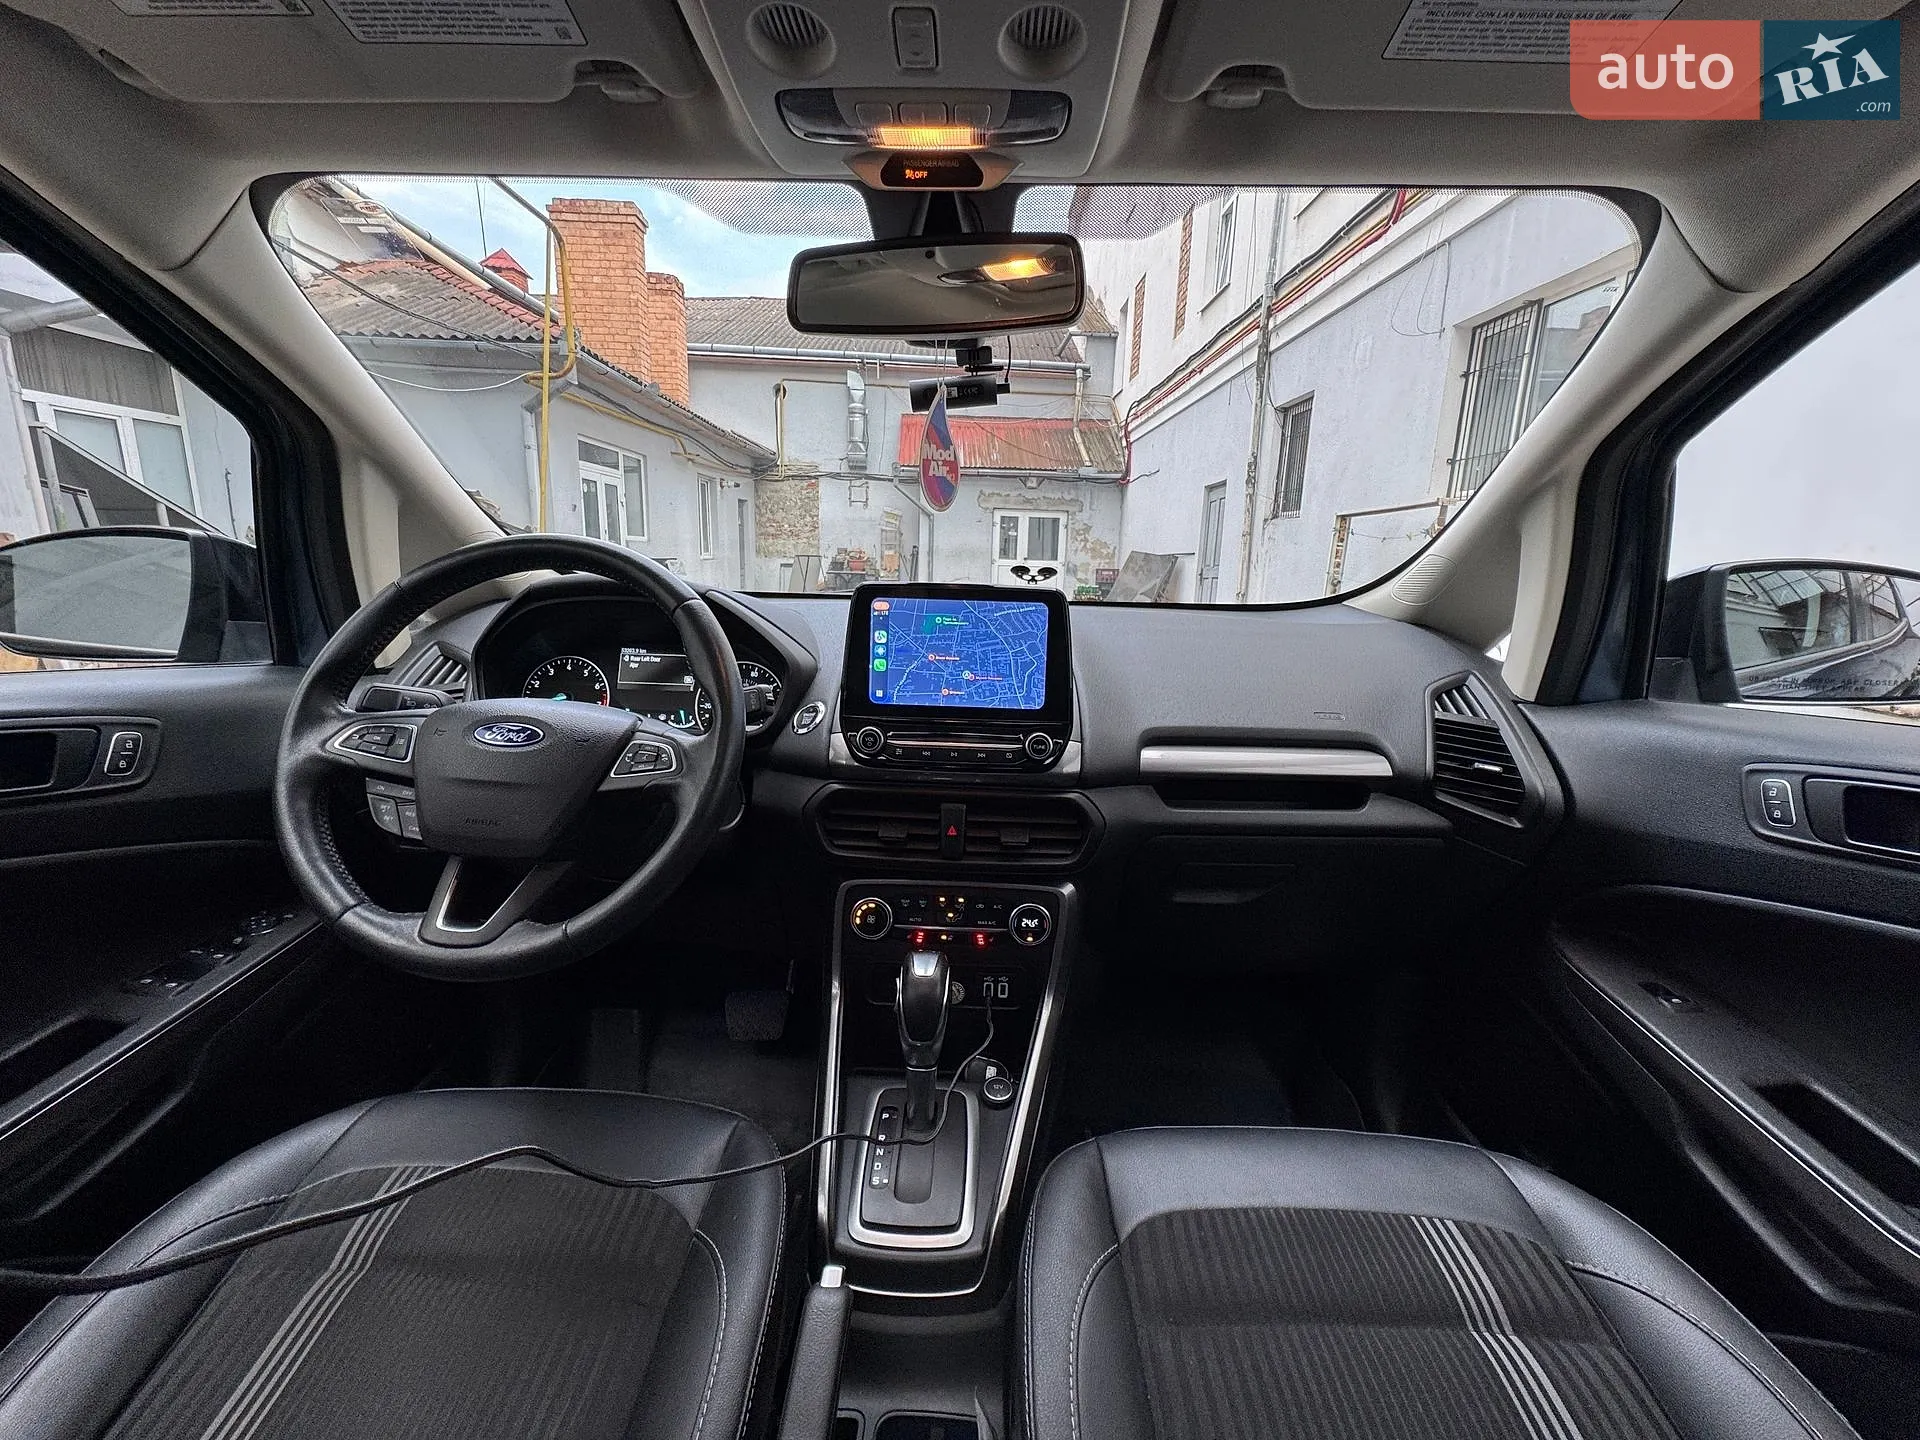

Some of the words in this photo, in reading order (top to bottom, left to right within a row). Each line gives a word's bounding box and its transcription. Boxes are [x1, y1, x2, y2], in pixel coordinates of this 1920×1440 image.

[914, 171, 928, 179] OFF
[921, 440, 955, 461] Mod
[928, 460, 947, 477] Air
[484, 725, 531, 742] Ford
[878, 1134, 886, 1142] R
[876, 1148, 884, 1156] N
[873, 1162, 882, 1171] D
[872, 1176, 880, 1185] S
